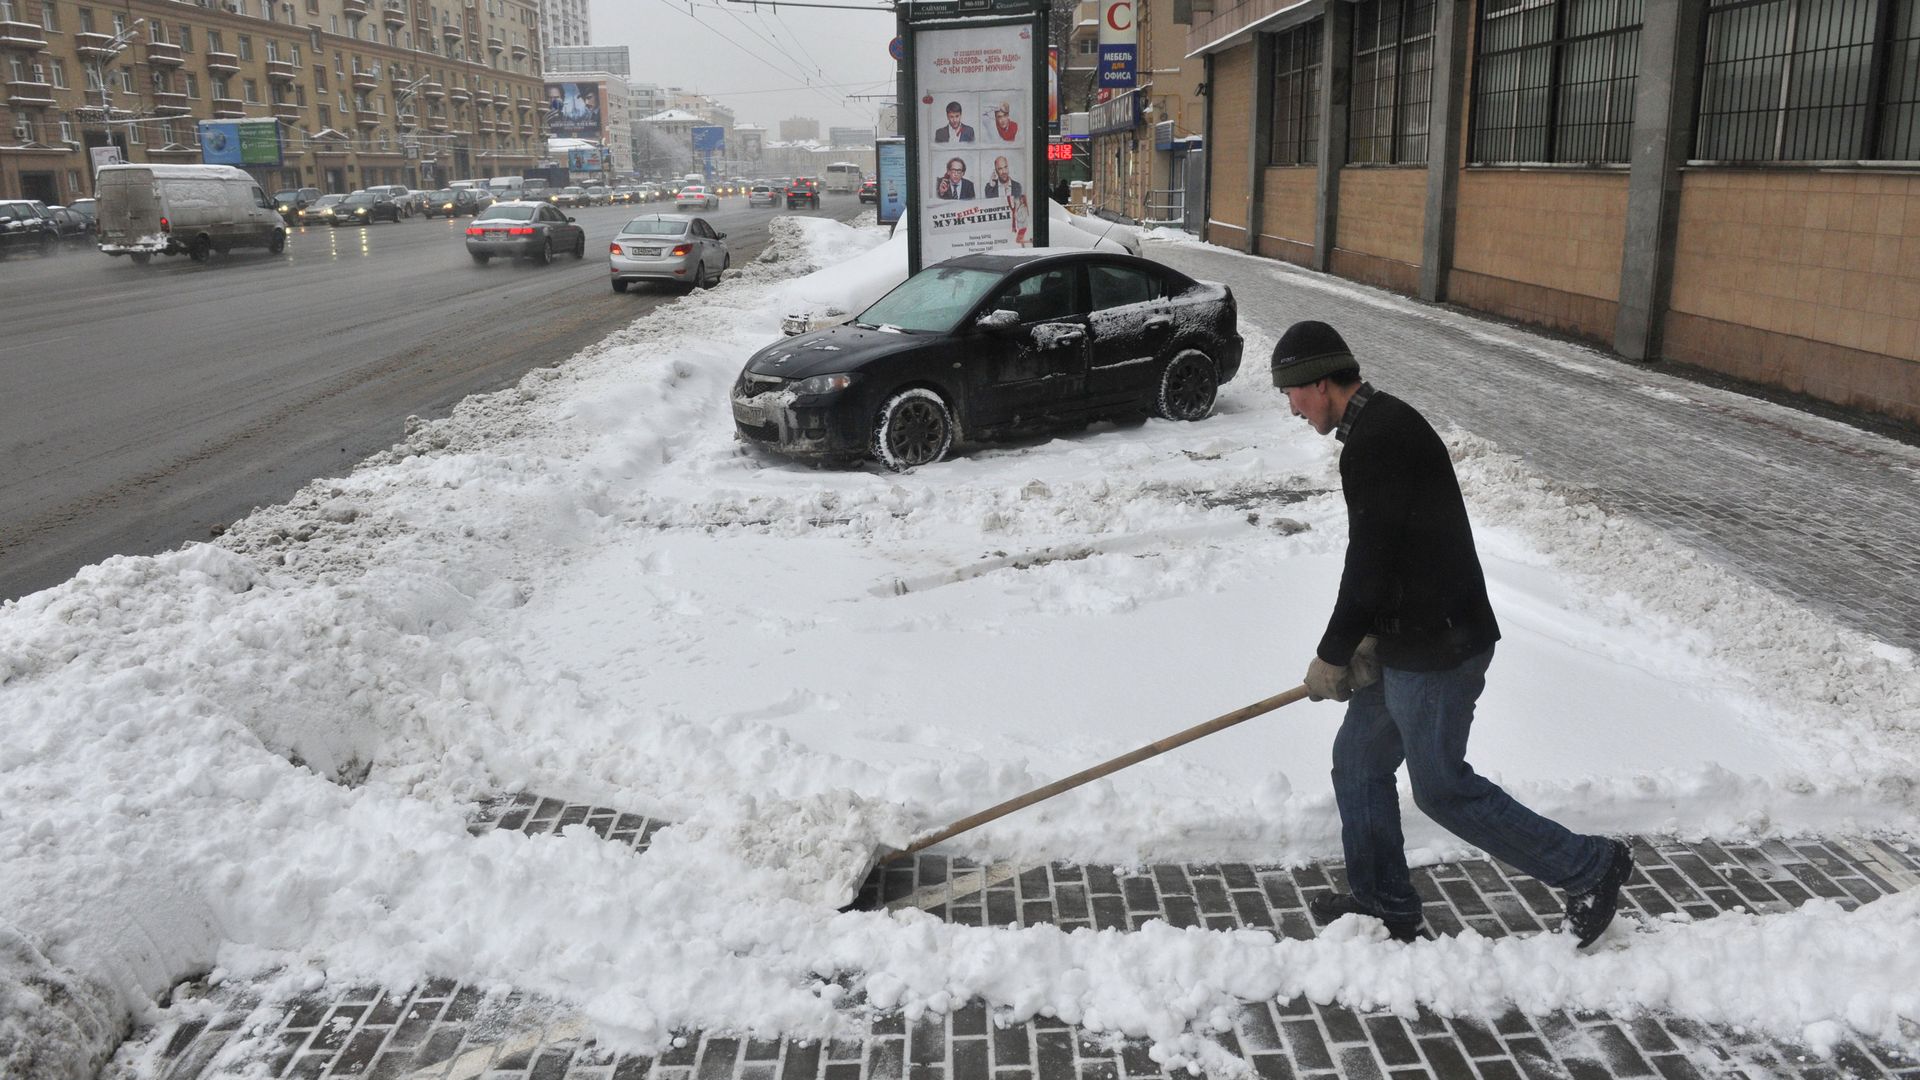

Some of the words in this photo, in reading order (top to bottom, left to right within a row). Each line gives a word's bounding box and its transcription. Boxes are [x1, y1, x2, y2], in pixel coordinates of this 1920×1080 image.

[1104, 52, 1132, 61] МЕБЕЛЬ
[961, 65, 984, 73] ГОВОРЯТ
[1104, 71, 1131, 80] ОФИСА
[1111, 95, 1133, 126] ОФИСА
[939, 211, 957, 219] ЧЕМ
[979, 205, 1010, 214] ГОВОРЯТ
[933, 211, 1011, 228] МУЖЧИНЫ
